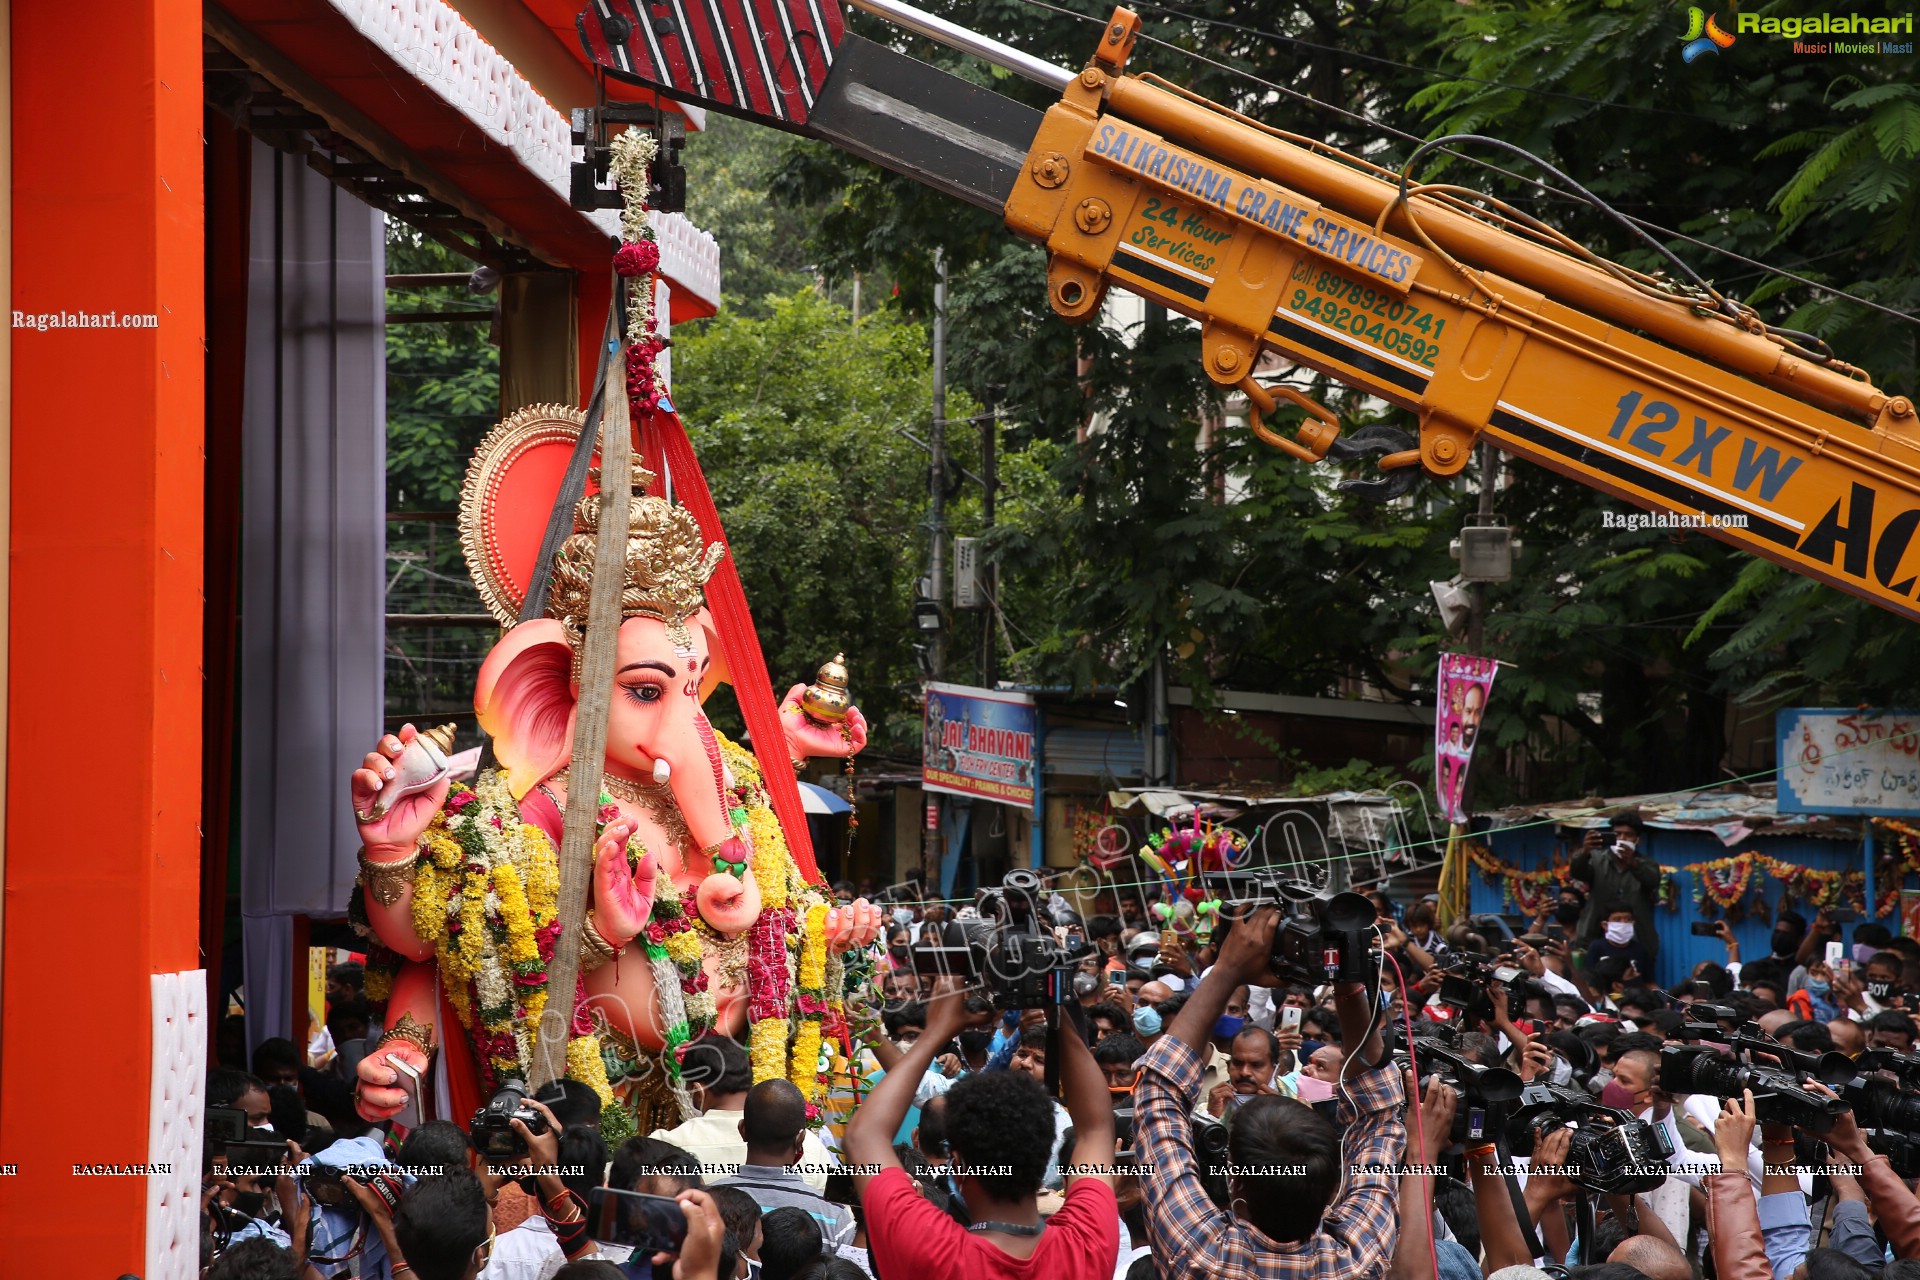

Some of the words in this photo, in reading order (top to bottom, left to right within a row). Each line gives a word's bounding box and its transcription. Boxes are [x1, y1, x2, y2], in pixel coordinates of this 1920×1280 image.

[1141, 198, 1178, 228] 24
[1181, 203, 1232, 246] Hour
[1236, 187, 1308, 240] CRANE
[1306, 217, 1412, 284] SERVICES
[1131, 226, 1216, 271] Services
[1290, 289, 1440, 368] 9492040592
[1797, 481, 1920, 603] AC
[941, 719, 963, 750] JAI
[968, 724, 1032, 762] BHAVANI
[925, 769, 939, 780] OUR
[1868, 982, 1889, 997] BOY
[373, 1176, 397, 1206] Canon
